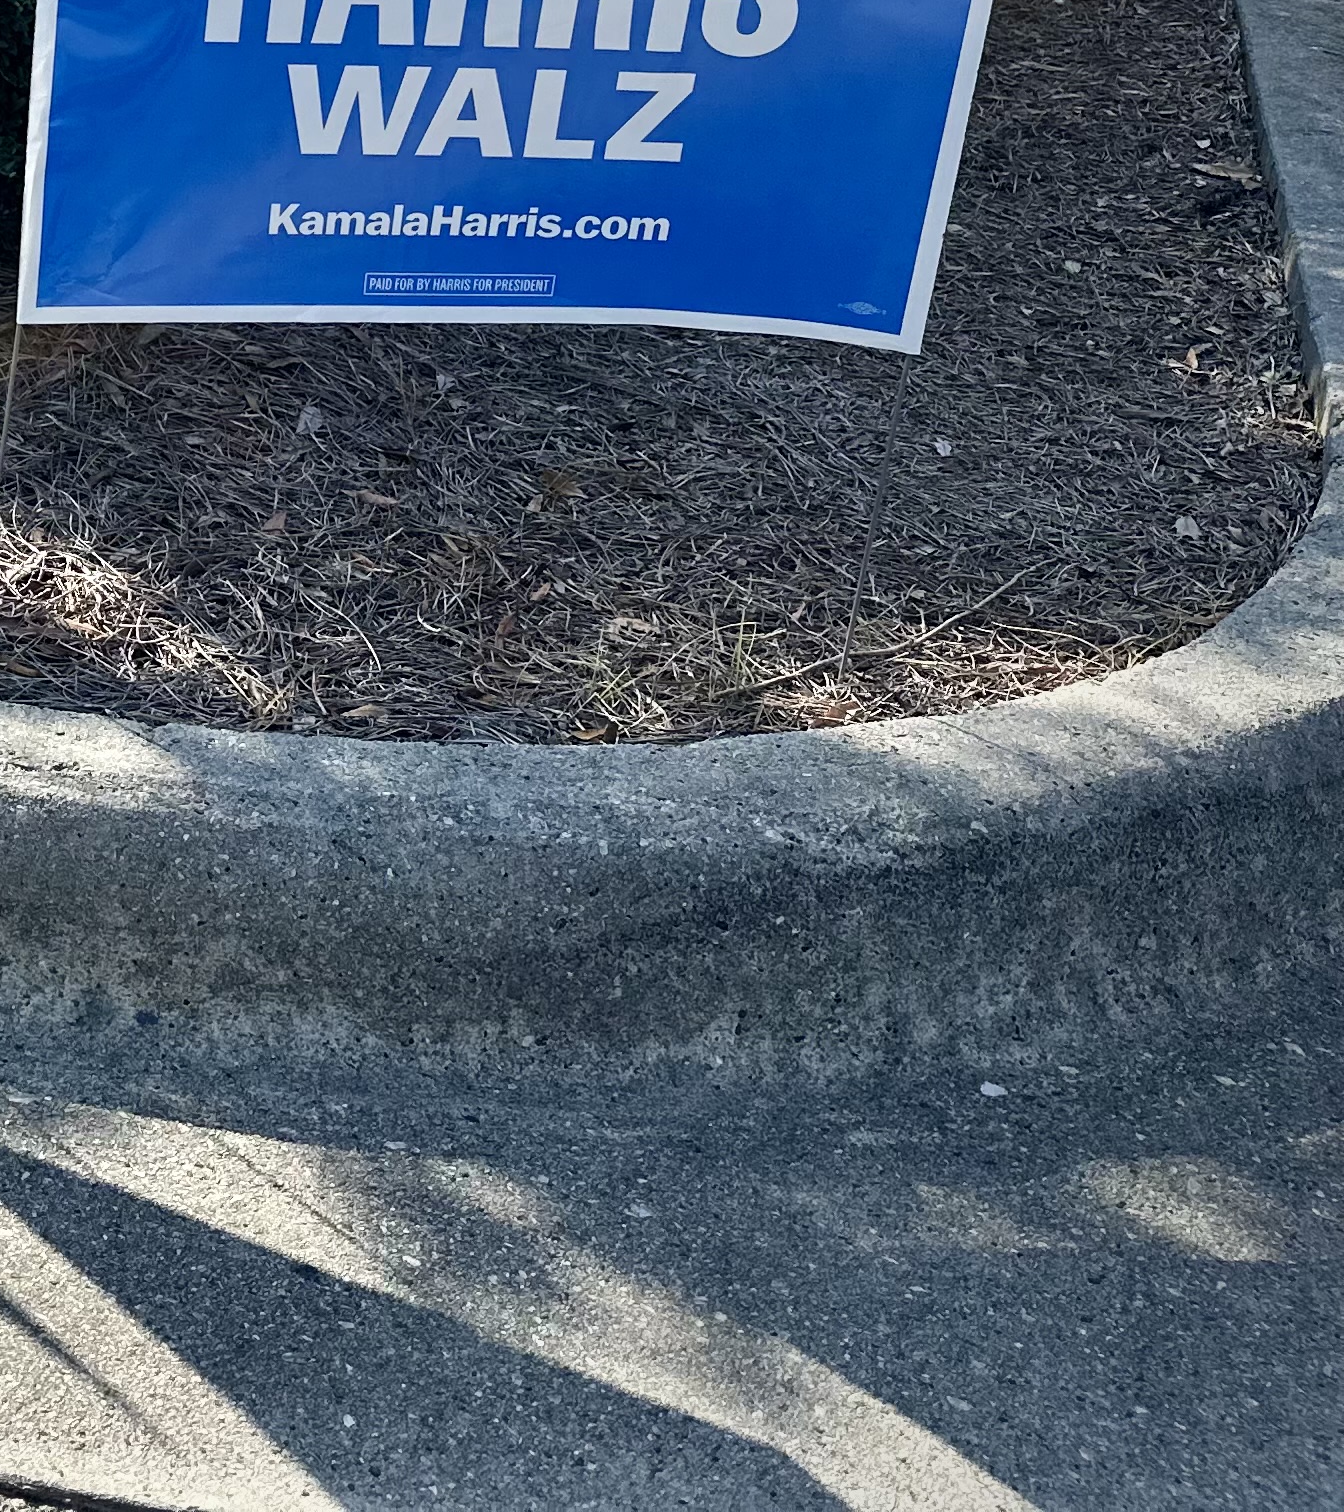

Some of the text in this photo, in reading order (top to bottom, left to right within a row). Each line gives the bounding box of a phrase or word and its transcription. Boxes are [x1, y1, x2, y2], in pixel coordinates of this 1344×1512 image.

[286, 63, 698, 164] WALZ
[266, 201, 672, 242] KamalaHarris.com
[368, 277, 551, 292] PAID FOR BY HARRIS FOR PRESIDENT
